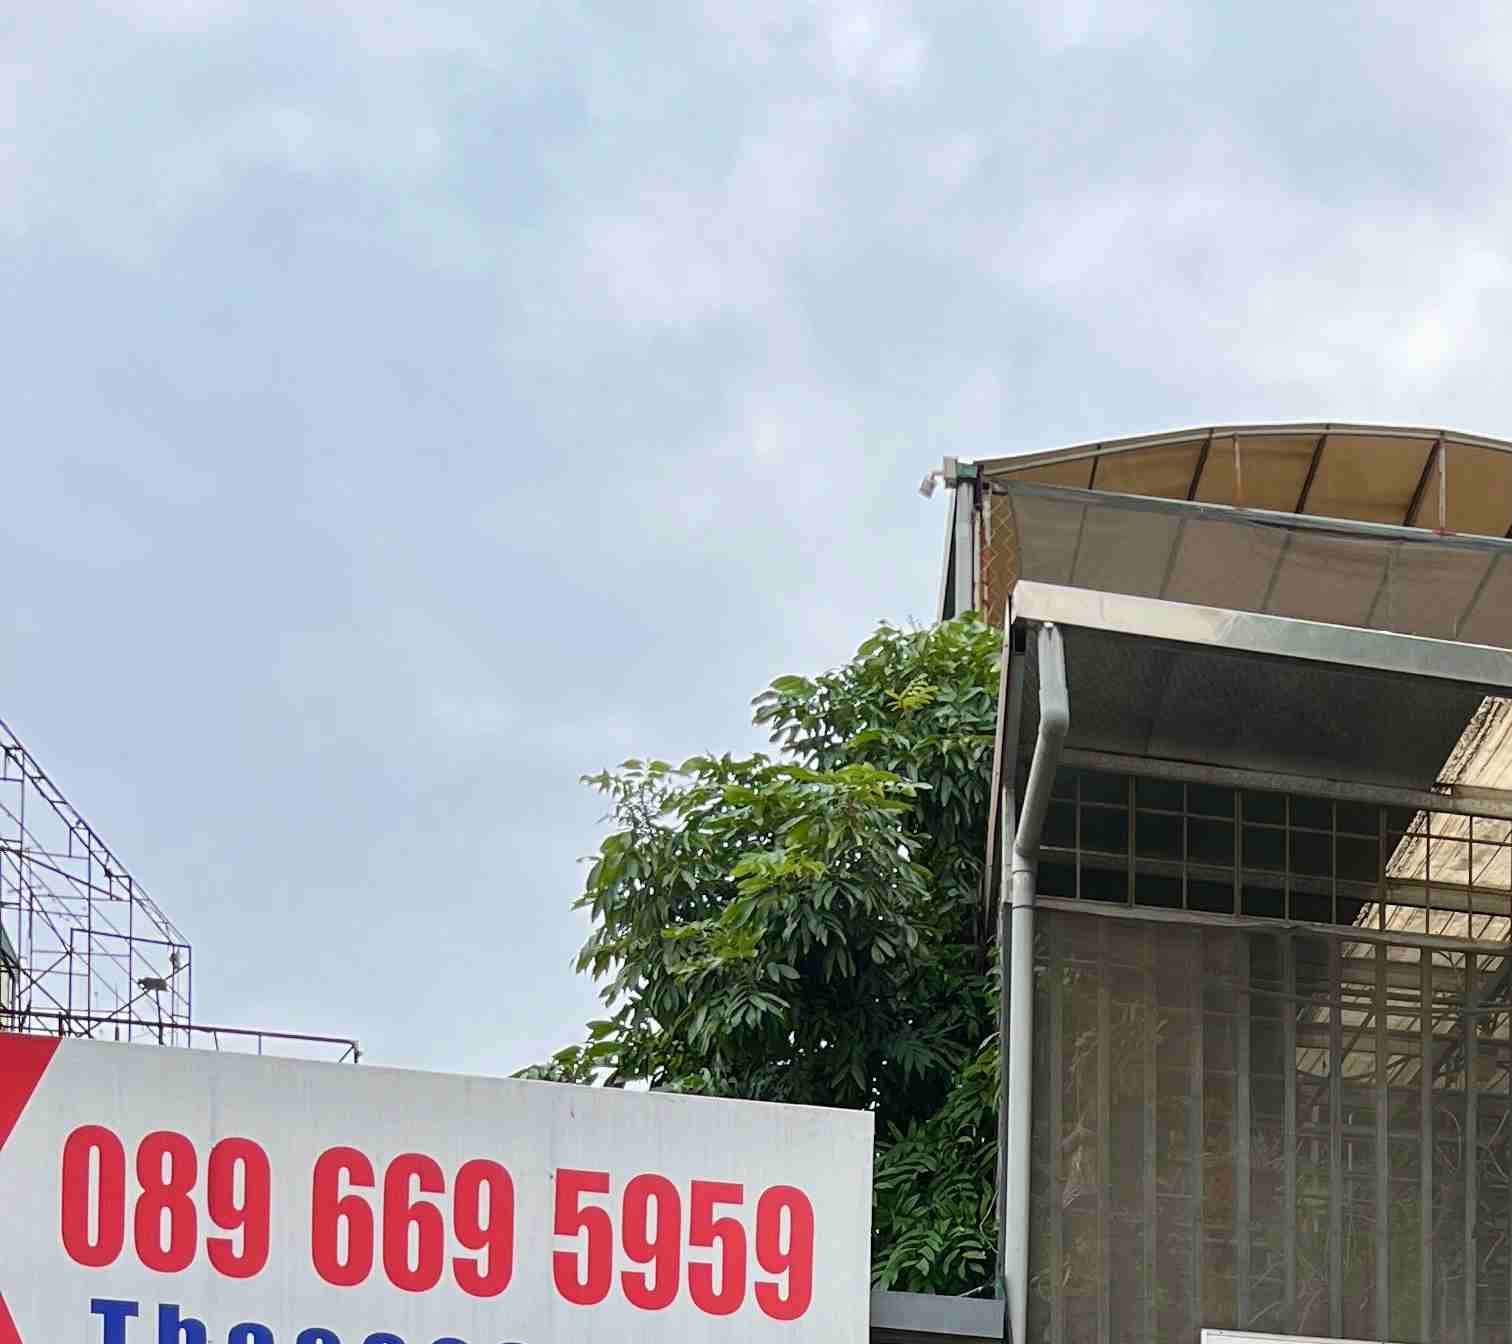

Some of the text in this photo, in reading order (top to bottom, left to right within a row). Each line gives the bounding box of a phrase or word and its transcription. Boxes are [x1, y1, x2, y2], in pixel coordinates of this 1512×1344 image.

[61, 1124, 815, 1321] 089 669 5959
